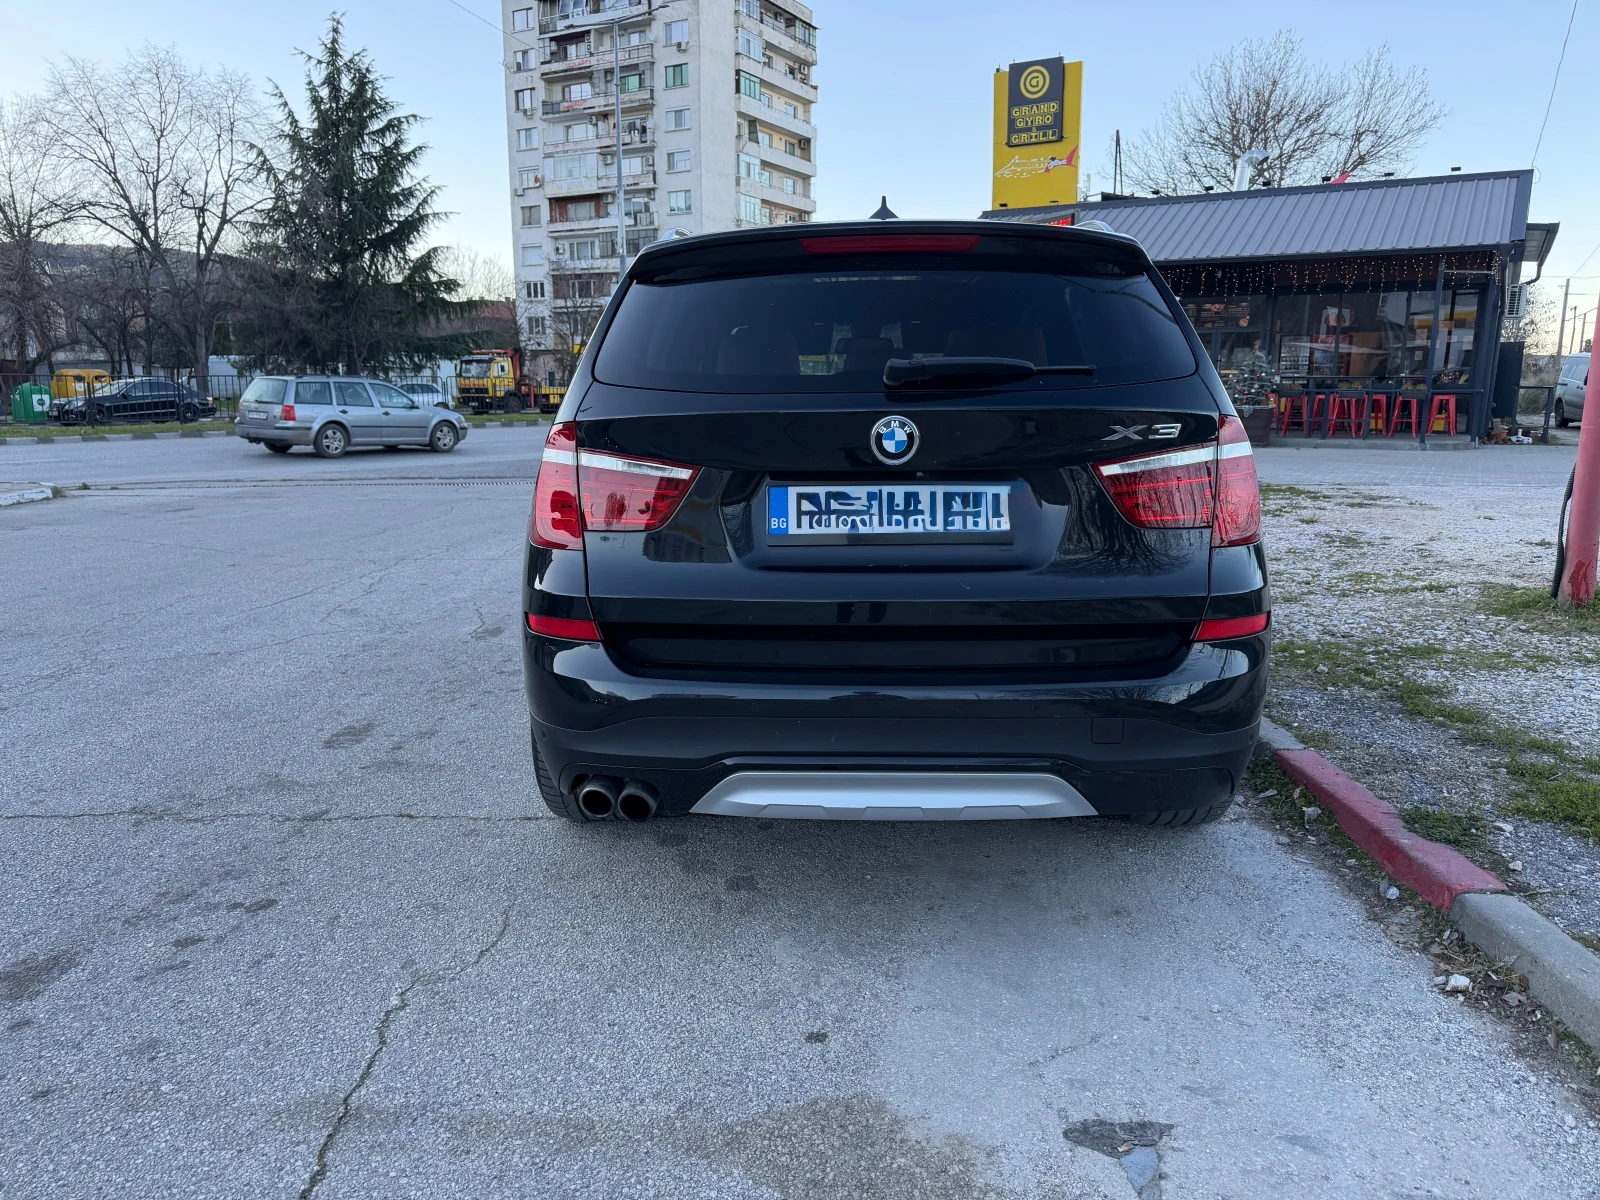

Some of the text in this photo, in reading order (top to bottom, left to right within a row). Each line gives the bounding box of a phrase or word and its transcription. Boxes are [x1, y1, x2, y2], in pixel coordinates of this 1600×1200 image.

[1012, 102, 1058, 117] GRAND
[1016, 114, 1052, 127] GYRO
[1011, 130, 1057, 144] GRILL
[877, 420, 913, 434] BMW
[1100, 423, 1182, 441] X3
[770, 518, 787, 529] BG
